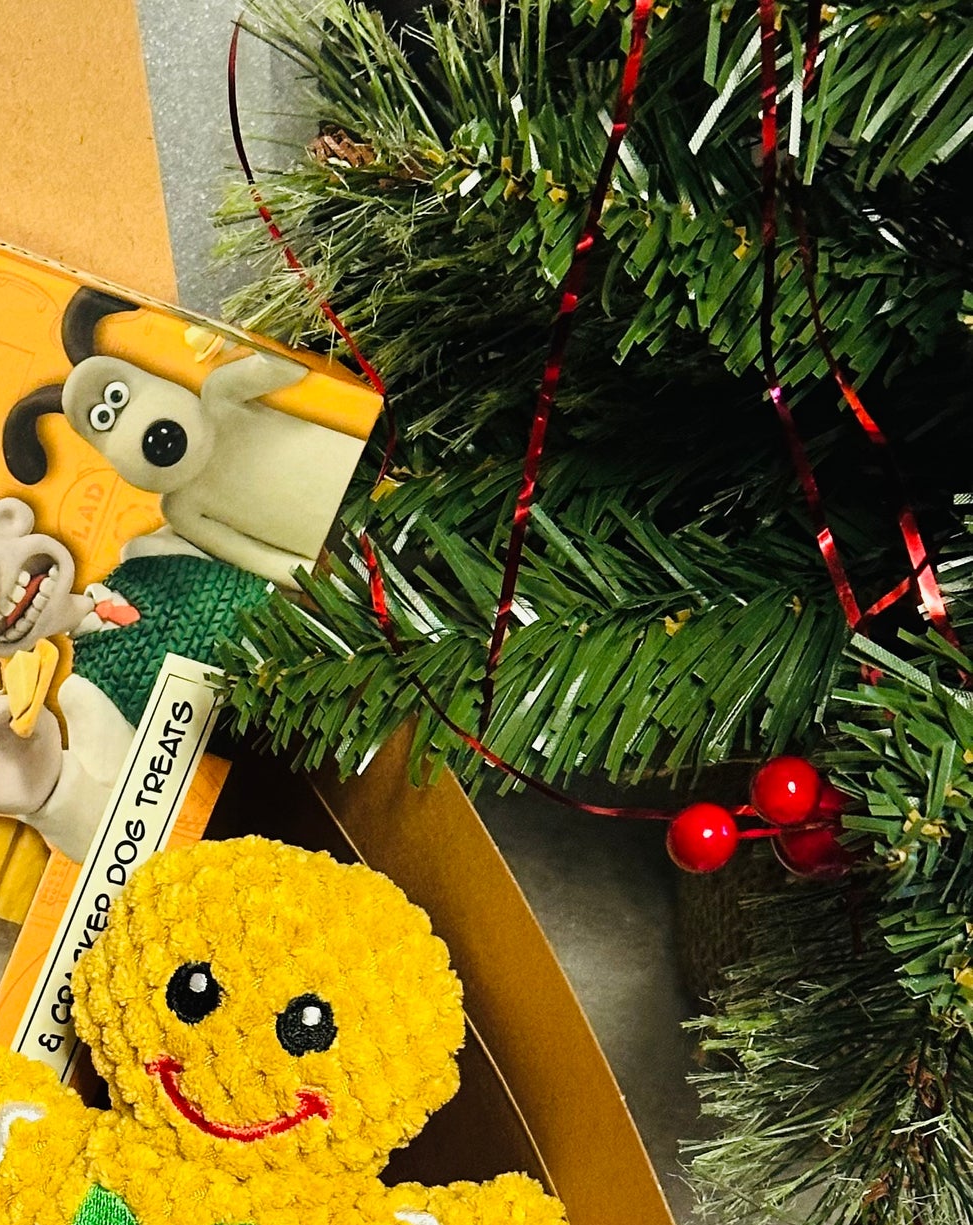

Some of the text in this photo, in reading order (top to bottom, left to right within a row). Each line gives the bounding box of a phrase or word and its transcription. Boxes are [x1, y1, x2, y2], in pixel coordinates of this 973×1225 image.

[38, 700, 194, 1053] & CRKER DOG TREATS
